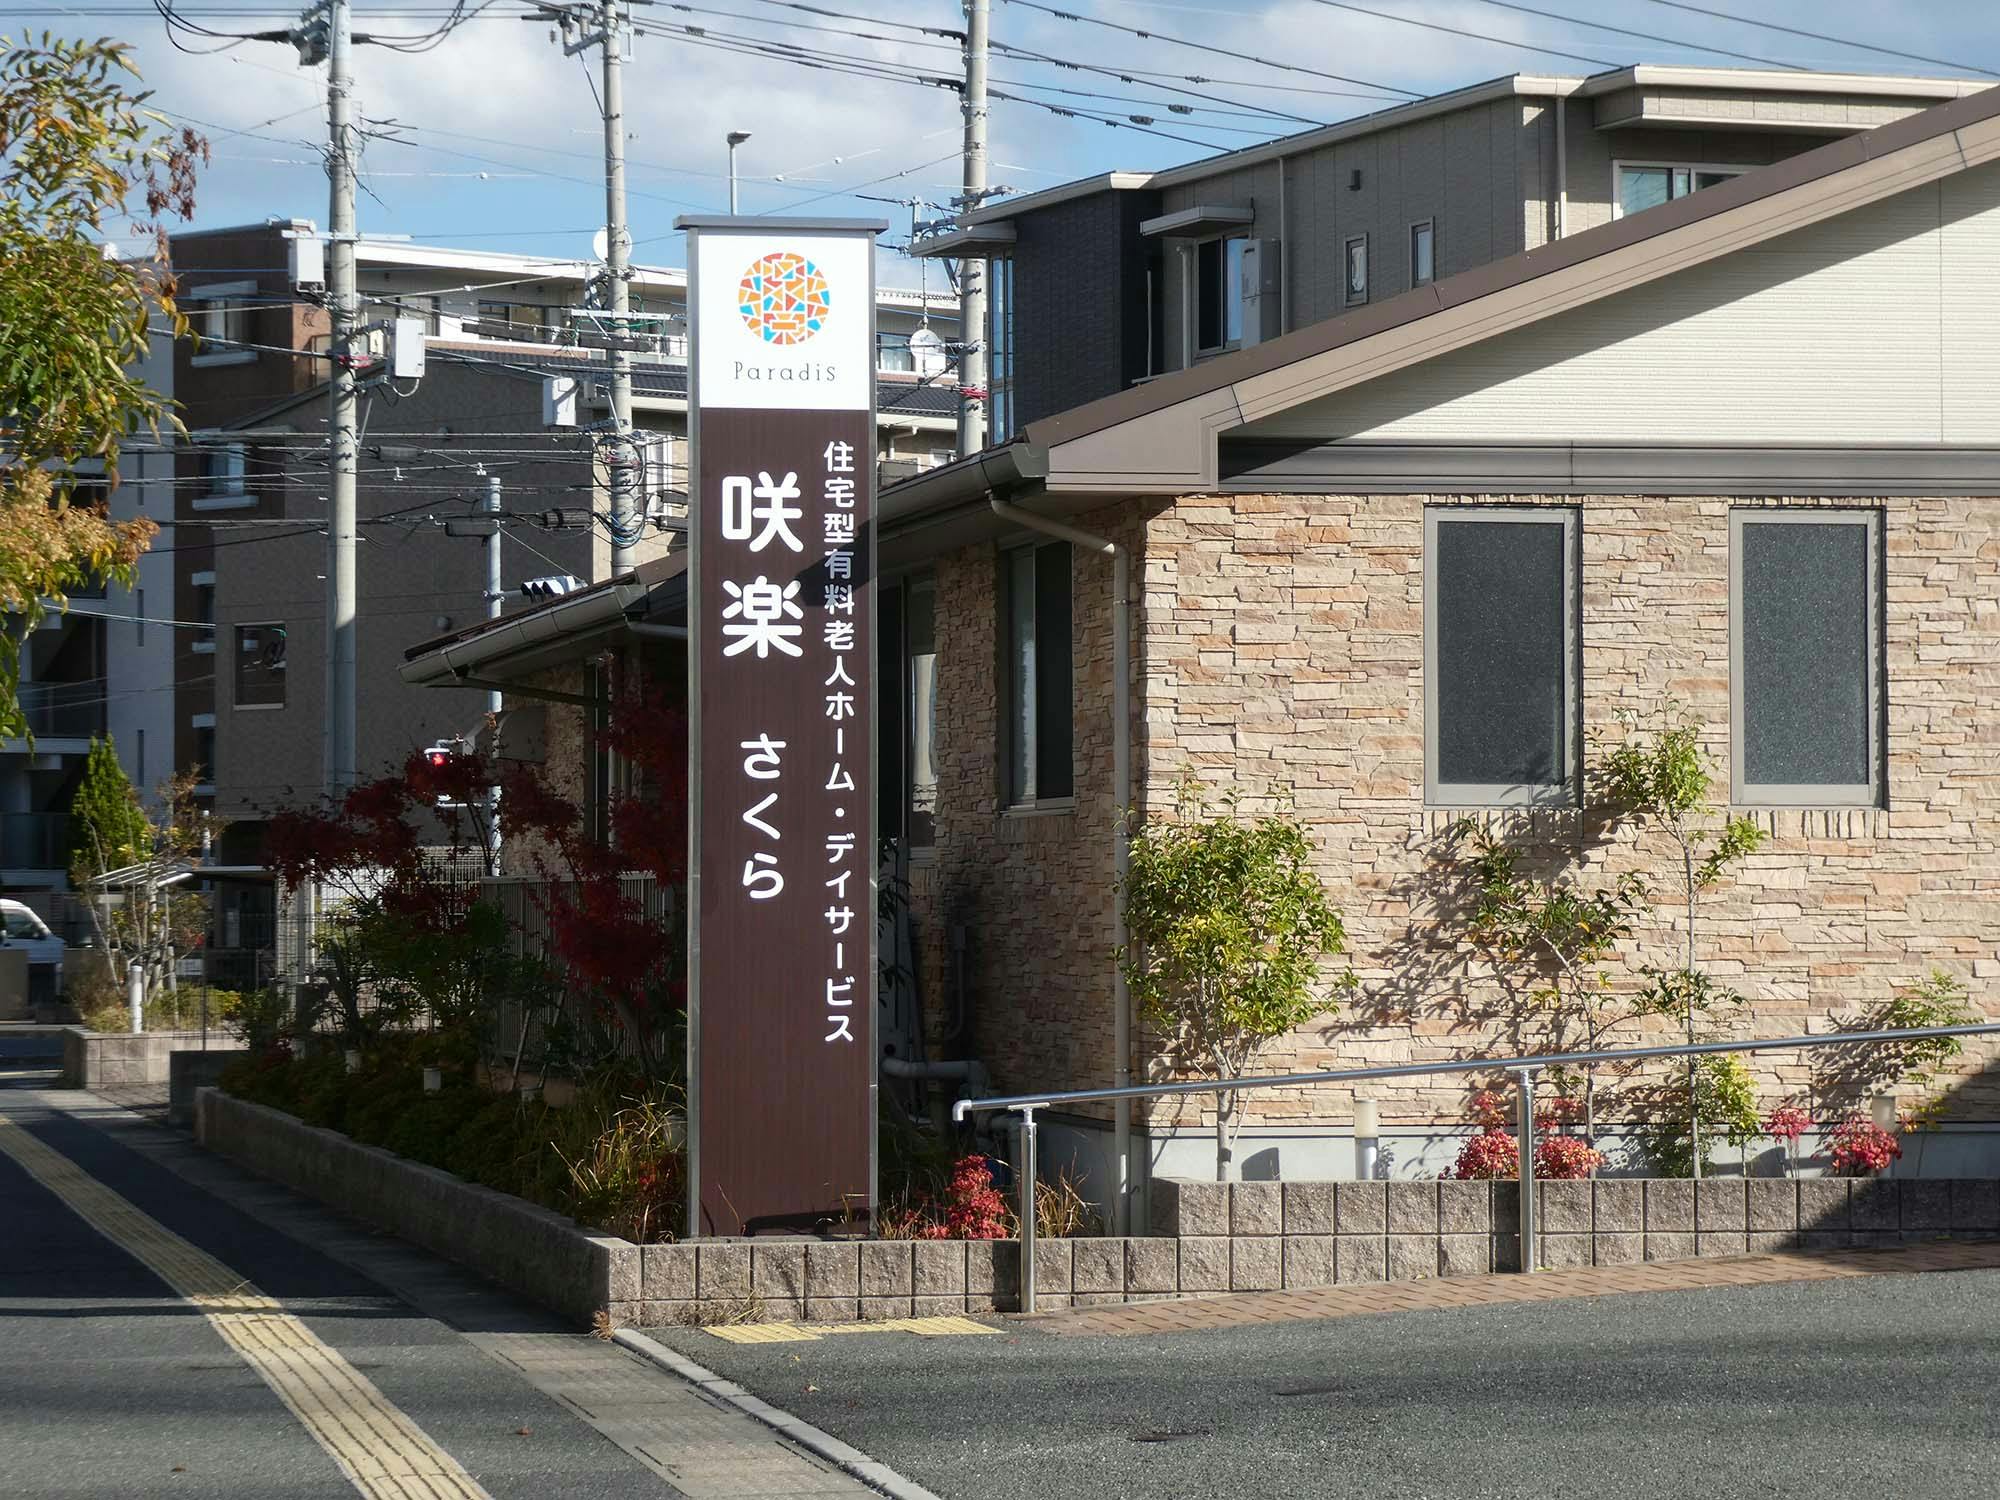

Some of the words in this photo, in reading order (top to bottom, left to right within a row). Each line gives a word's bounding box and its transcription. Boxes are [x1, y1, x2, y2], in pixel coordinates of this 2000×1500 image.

[721, 471, 804, 659] 咲楽
[740, 732, 787, 899] さくら
[823, 440, 856, 1042] 住宅型有料老人ホーム・デイサービス
